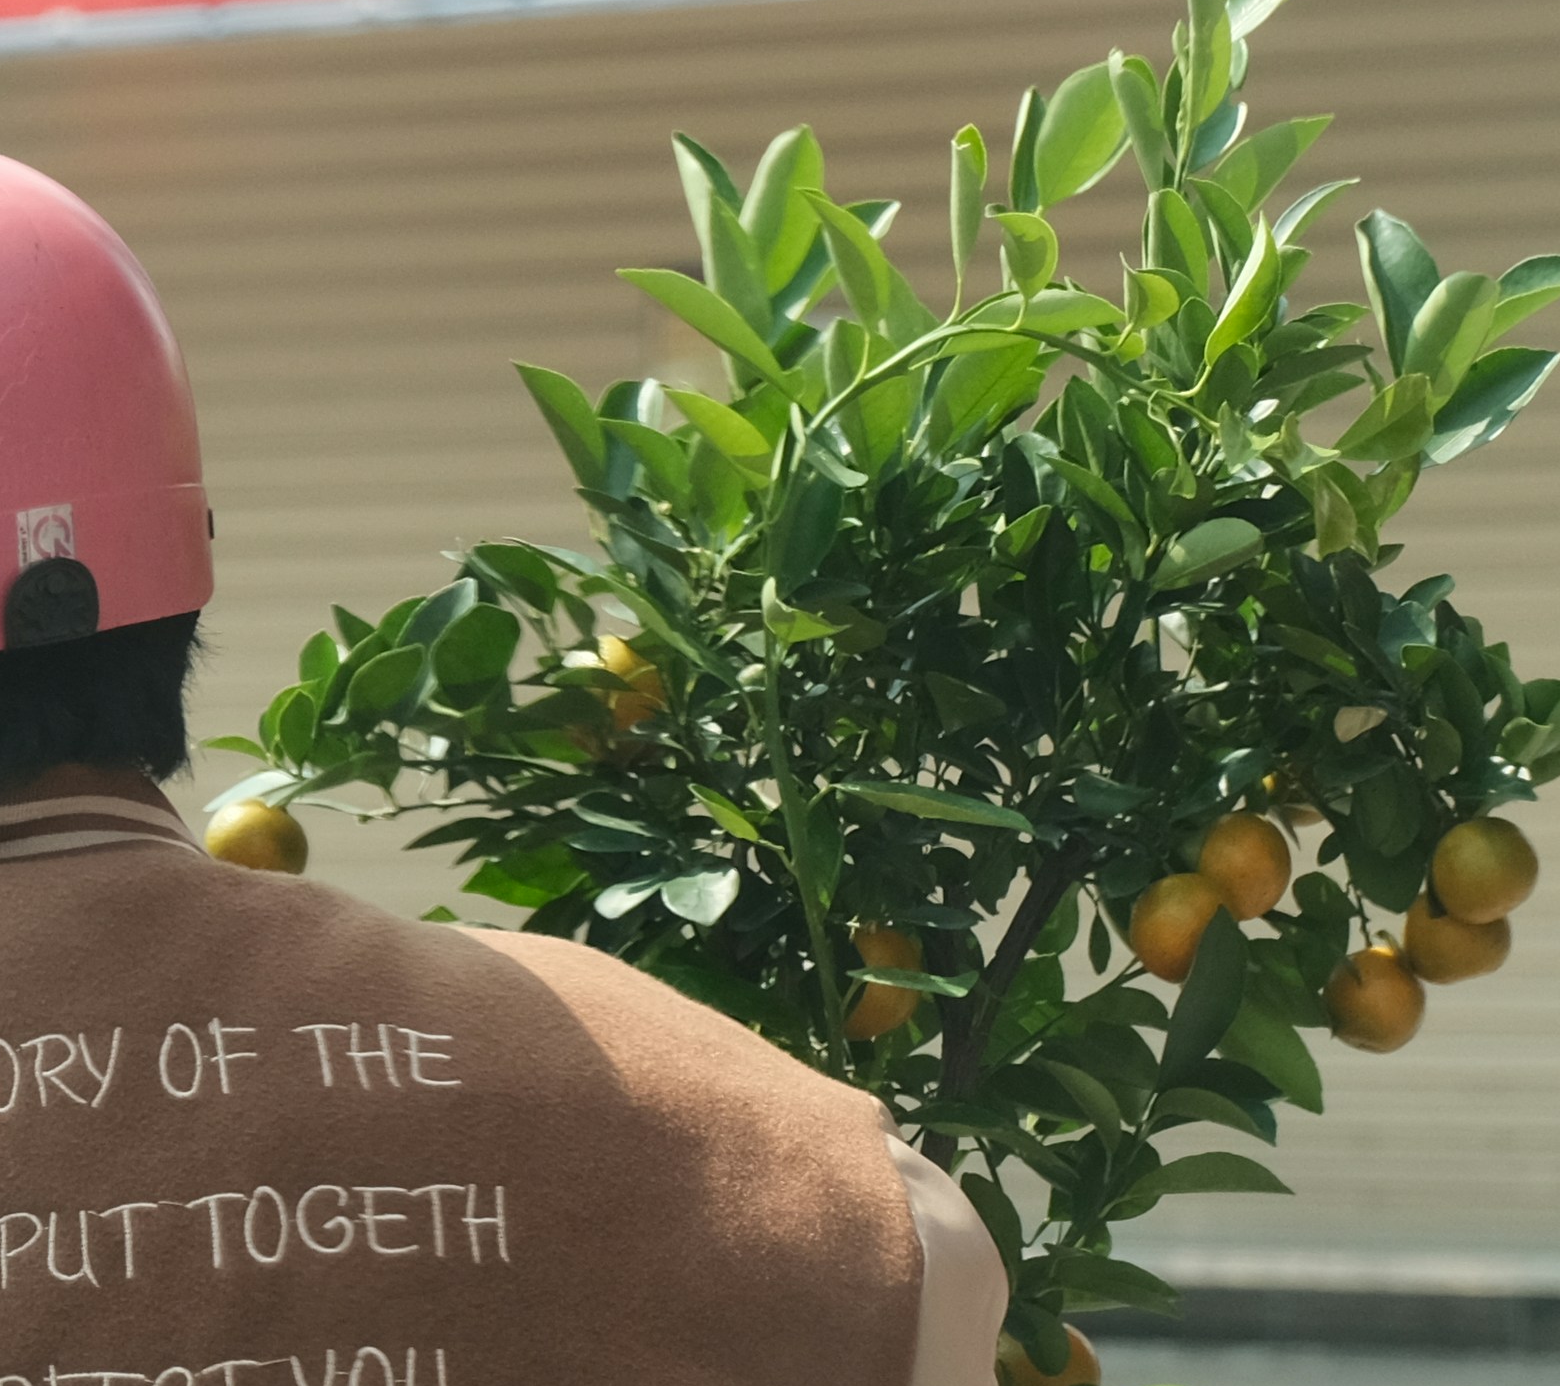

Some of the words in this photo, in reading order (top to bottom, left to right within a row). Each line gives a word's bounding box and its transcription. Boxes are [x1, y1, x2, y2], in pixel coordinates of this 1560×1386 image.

[160, 1018, 257, 1099] OF
[292, 1022, 462, 1089] THE
[184, 1183, 511, 1271] TOGETH
